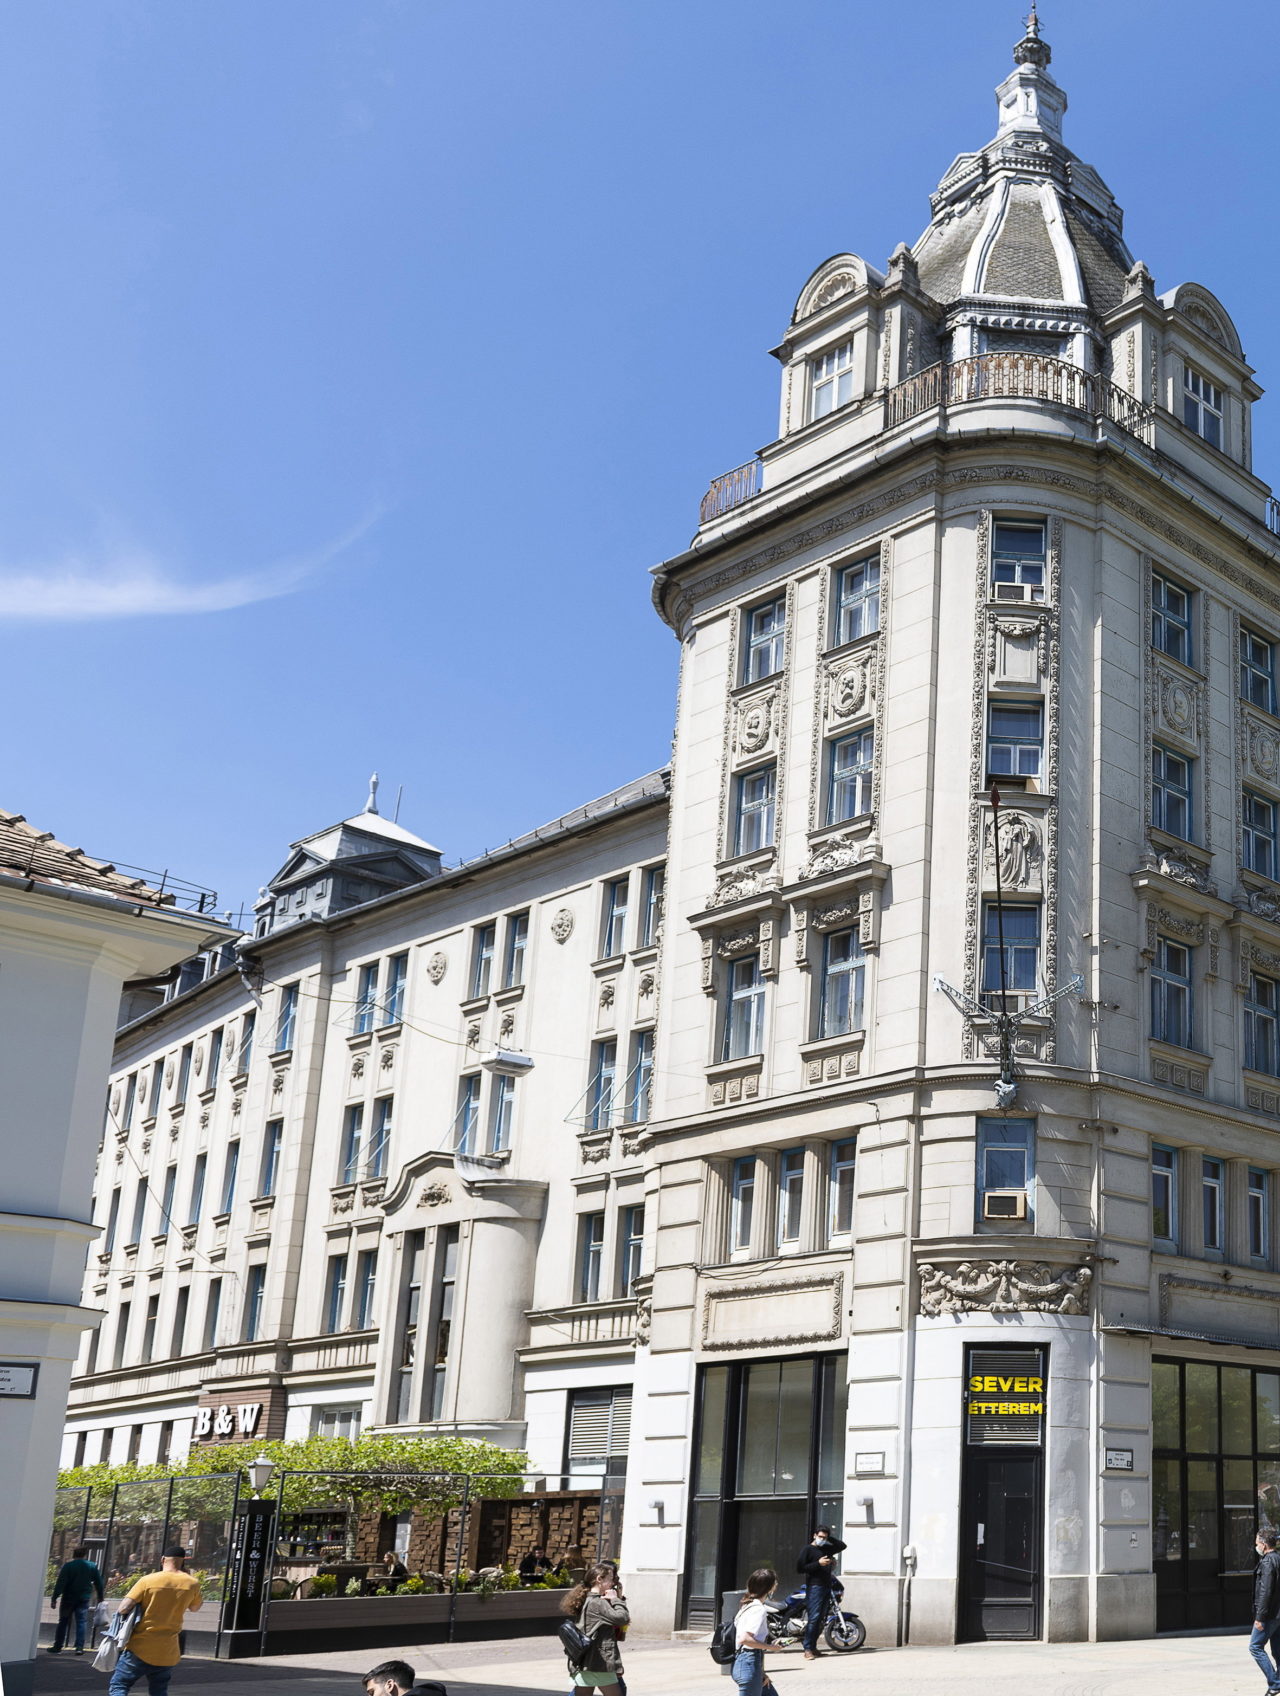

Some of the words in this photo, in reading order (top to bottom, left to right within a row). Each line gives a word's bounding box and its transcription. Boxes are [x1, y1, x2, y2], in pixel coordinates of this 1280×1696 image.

[969, 1376, 1043, 1392] SEVER
[968, 1400, 1043, 1415] ÉTTEREM
[252, 1514, 263, 1549] BEER
[247, 1560, 258, 1598] WURST
